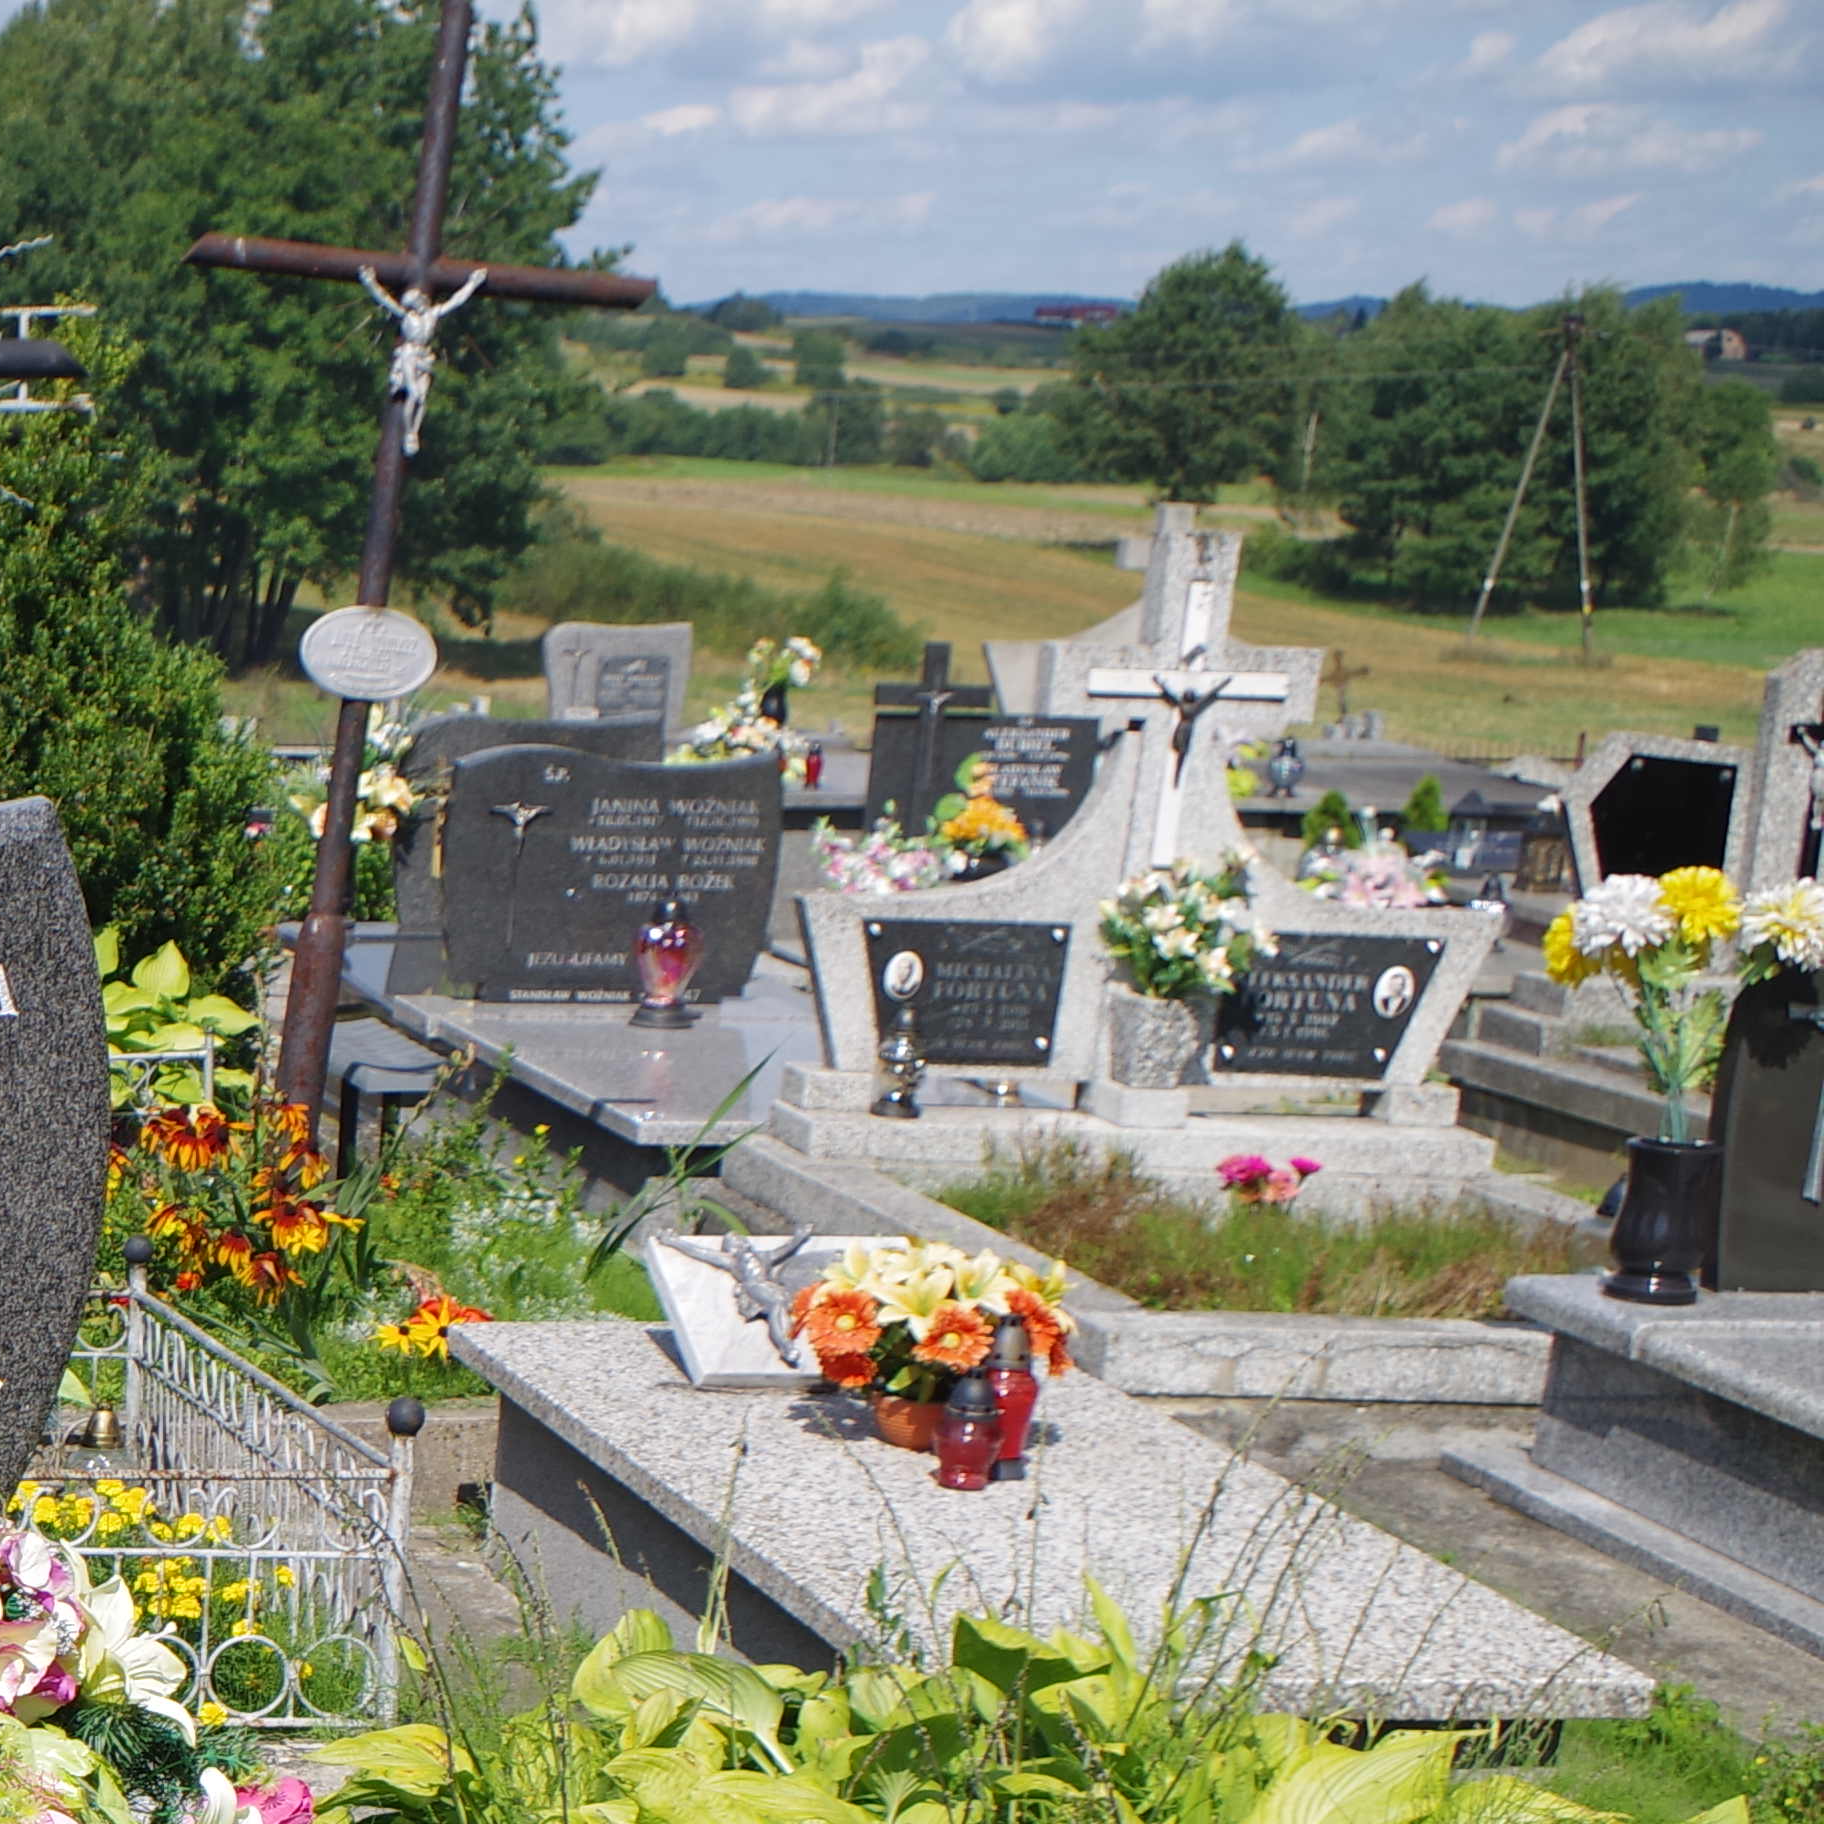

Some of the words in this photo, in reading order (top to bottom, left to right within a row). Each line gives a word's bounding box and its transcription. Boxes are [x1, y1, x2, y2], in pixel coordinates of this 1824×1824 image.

[591, 797, 660, 816] JANINA
[592, 871, 670, 890] ROZALIA
[933, 979, 1048, 1000] FORTUNA
